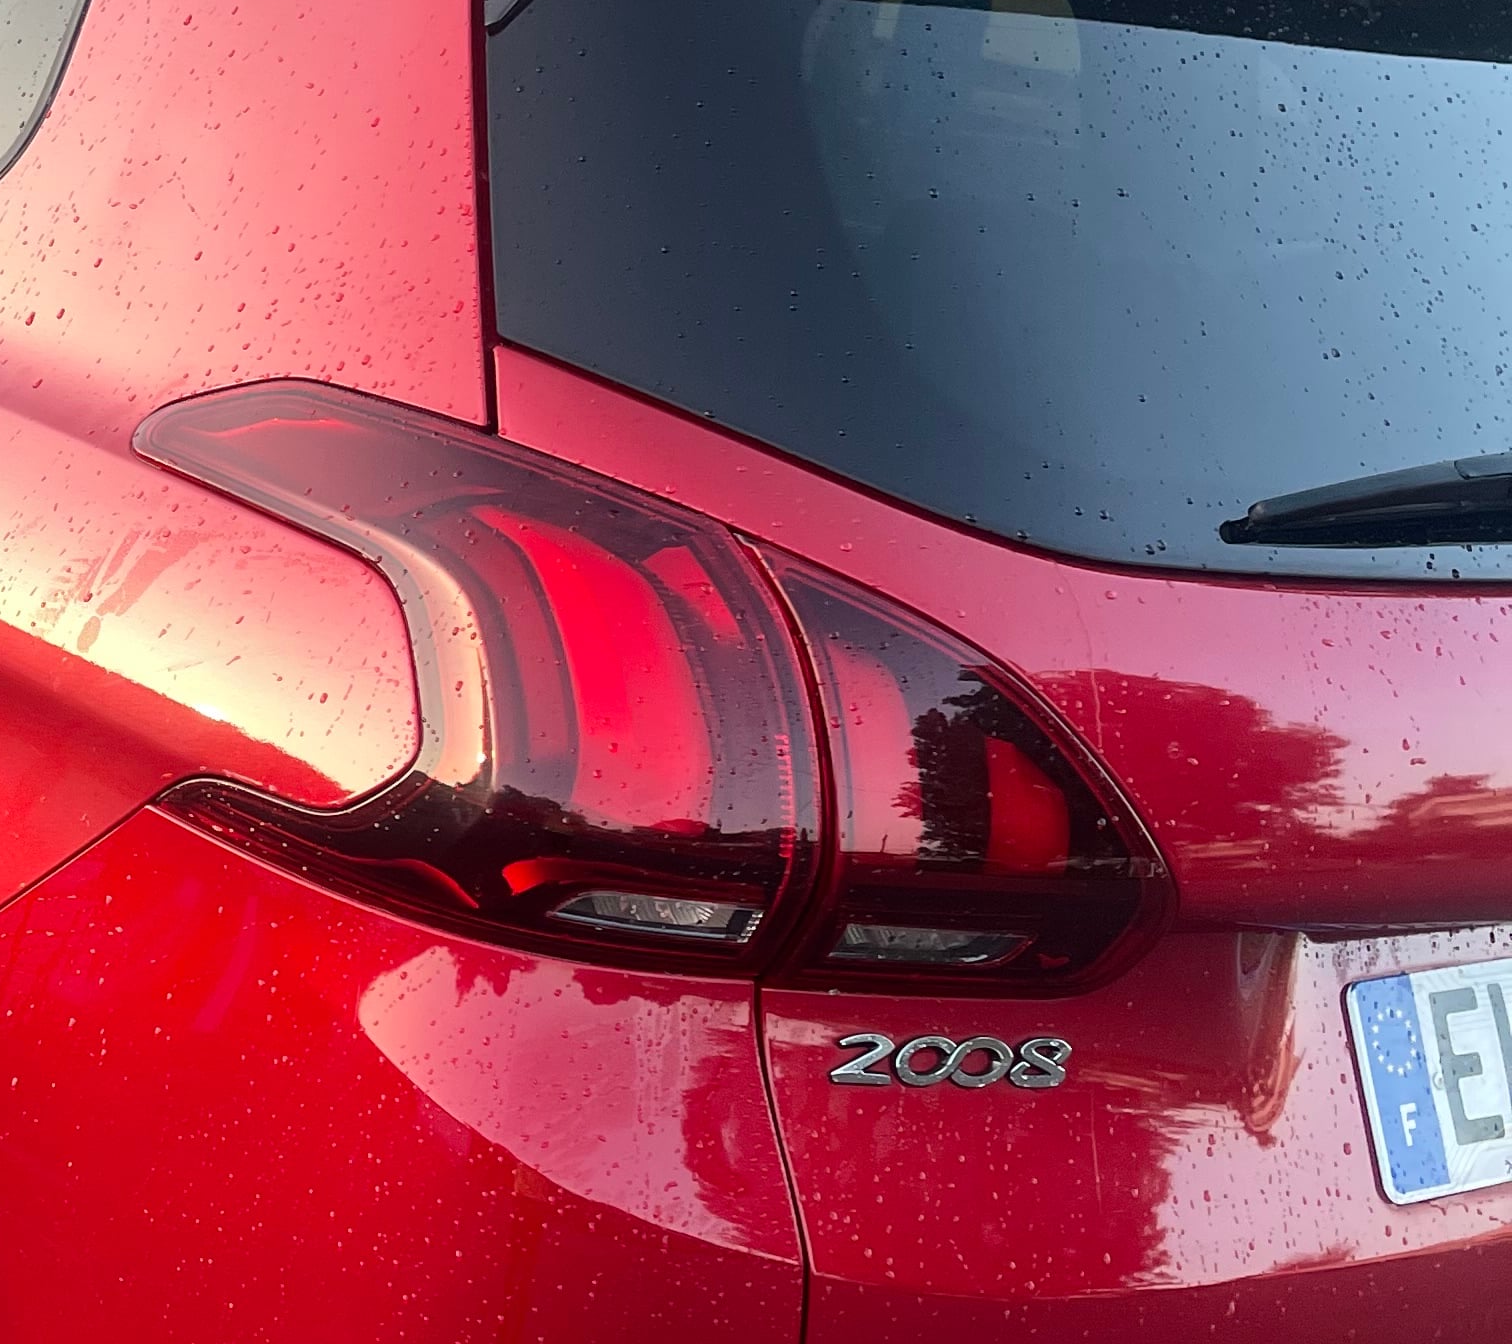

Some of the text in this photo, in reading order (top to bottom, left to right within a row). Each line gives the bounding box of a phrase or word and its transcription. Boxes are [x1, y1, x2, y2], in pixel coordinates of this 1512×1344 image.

[828, 1033, 1073, 1089] 2008
[1399, 983, 1512, 1147] F E
